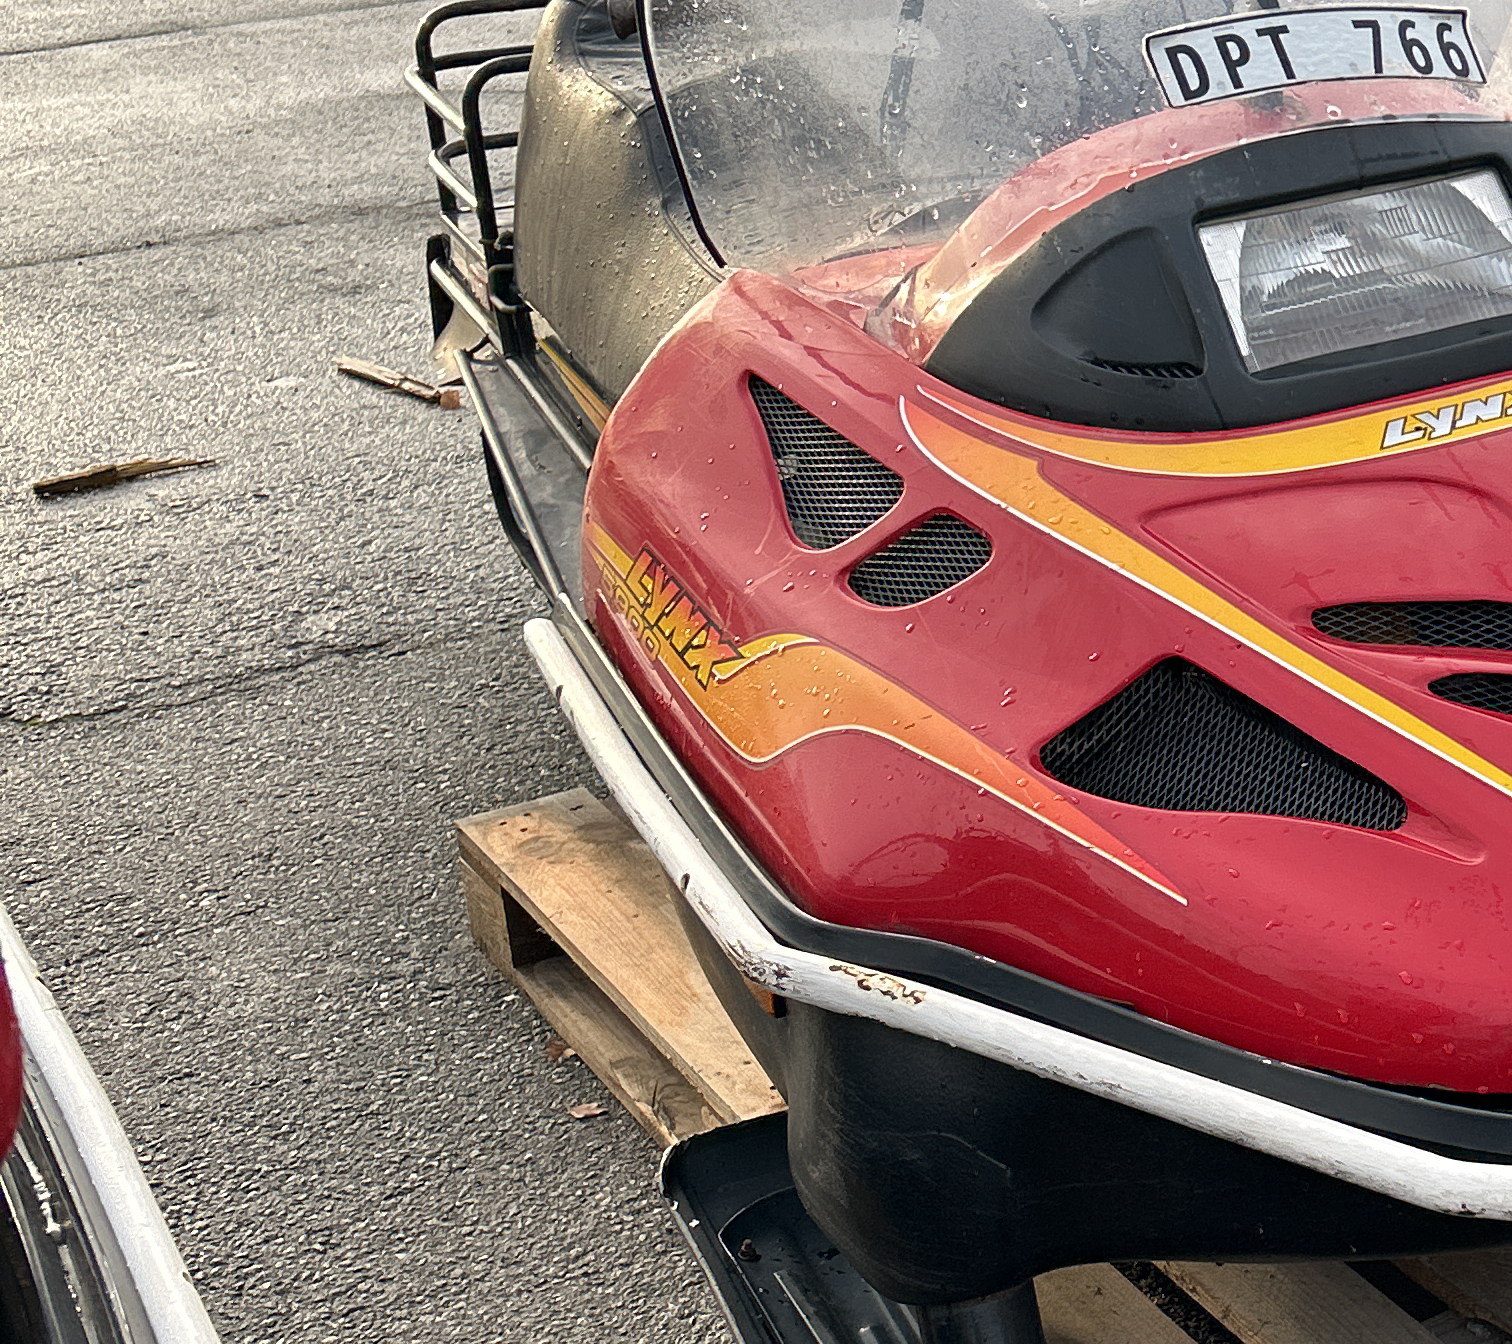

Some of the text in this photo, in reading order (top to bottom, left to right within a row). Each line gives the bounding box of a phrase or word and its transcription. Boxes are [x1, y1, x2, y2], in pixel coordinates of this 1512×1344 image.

[1165, 18, 1471, 102] DPT 766
[626, 546, 746, 692] LYNX
